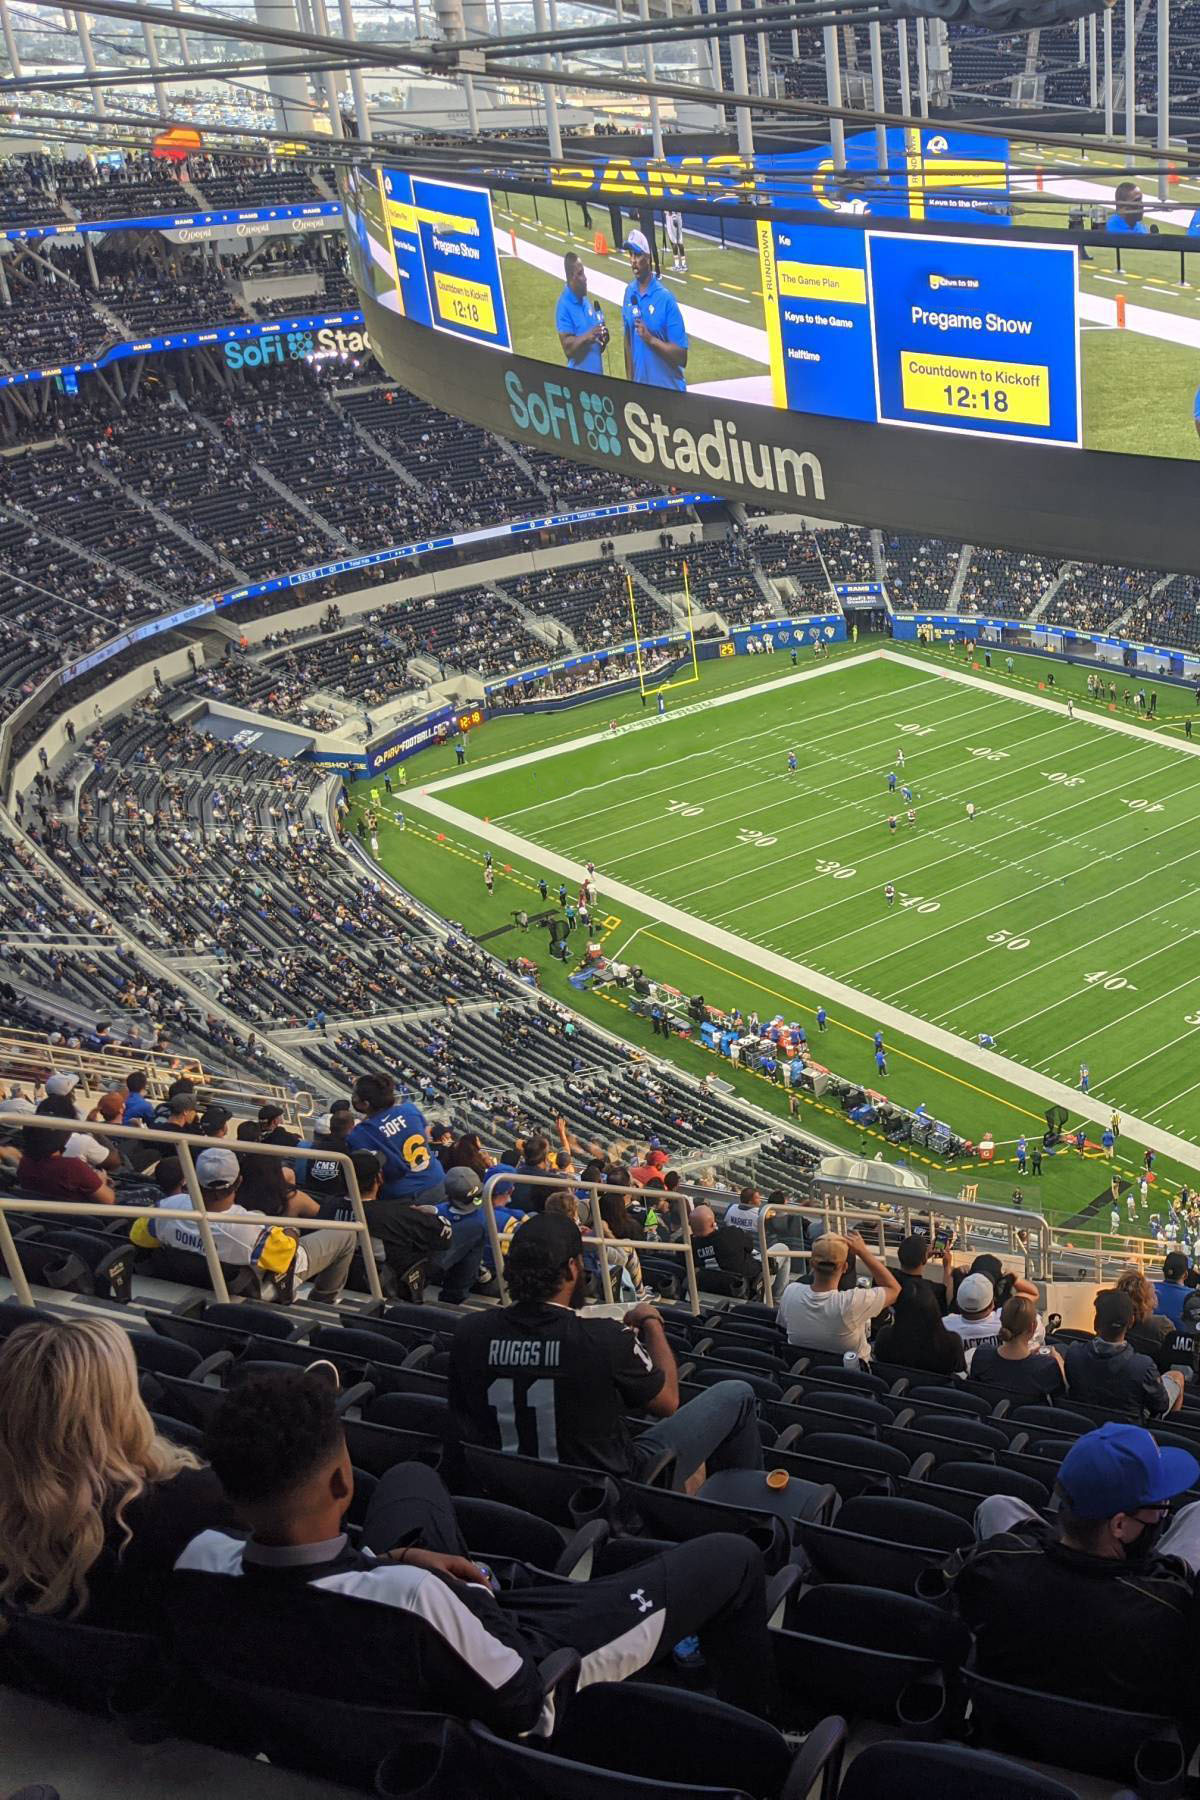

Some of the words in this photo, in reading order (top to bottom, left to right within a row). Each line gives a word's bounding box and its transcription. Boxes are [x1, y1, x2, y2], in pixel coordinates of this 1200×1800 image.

[432, 236, 460, 256] Pregame
[461, 244, 480, 260] Show
[761, 230, 774, 291] RUNDOWN
[781, 273, 797, 286] The
[797, 274, 821, 288] Game
[822, 276, 840, 289] Plan
[453, 300, 479, 322] 12:18
[785, 310, 805, 327] Keys
[805, 313, 815, 325] to
[815, 313, 828, 326] the
[829, 315, 853, 329] Game
[911, 306, 983, 335] Pregame
[985, 309, 1033, 335] Show
[224, 335, 285, 369] SoFi
[317, 328, 373, 353] Sta
[788, 347, 821, 363] Halftime
[908, 361, 978, 382] Countdown
[979, 368, 993, 383] to
[995, 369, 1041, 388] Kickoff
[943, 384, 1009, 413] 12:18
[504, 370, 580, 446] SoFi
[624, 401, 826, 500] Stadium
[721, 644, 734, 656] 25
[902, 723, 936, 737] 10
[972, 747, 1011, 762] 20
[1048, 772, 1086, 787] 30
[670, 800, 705, 818] 10
[1128, 798, 1166, 814] 40
[736, 831, 779, 848] 20
[815, 860, 858, 880] 30
[899, 895, 942, 915] 40
[986, 930, 1032, 951] 50
[1083, 970, 1128, 992] 40
[378, 1115, 408, 1138] GOFF
[316, 1161, 336, 1171] CMS
[697, 1245, 716, 1258] CARR
[488, 1339, 541, 1366] RUGGS
[544, 1340, 561, 1367] III
[487, 1378, 559, 1464] 11
